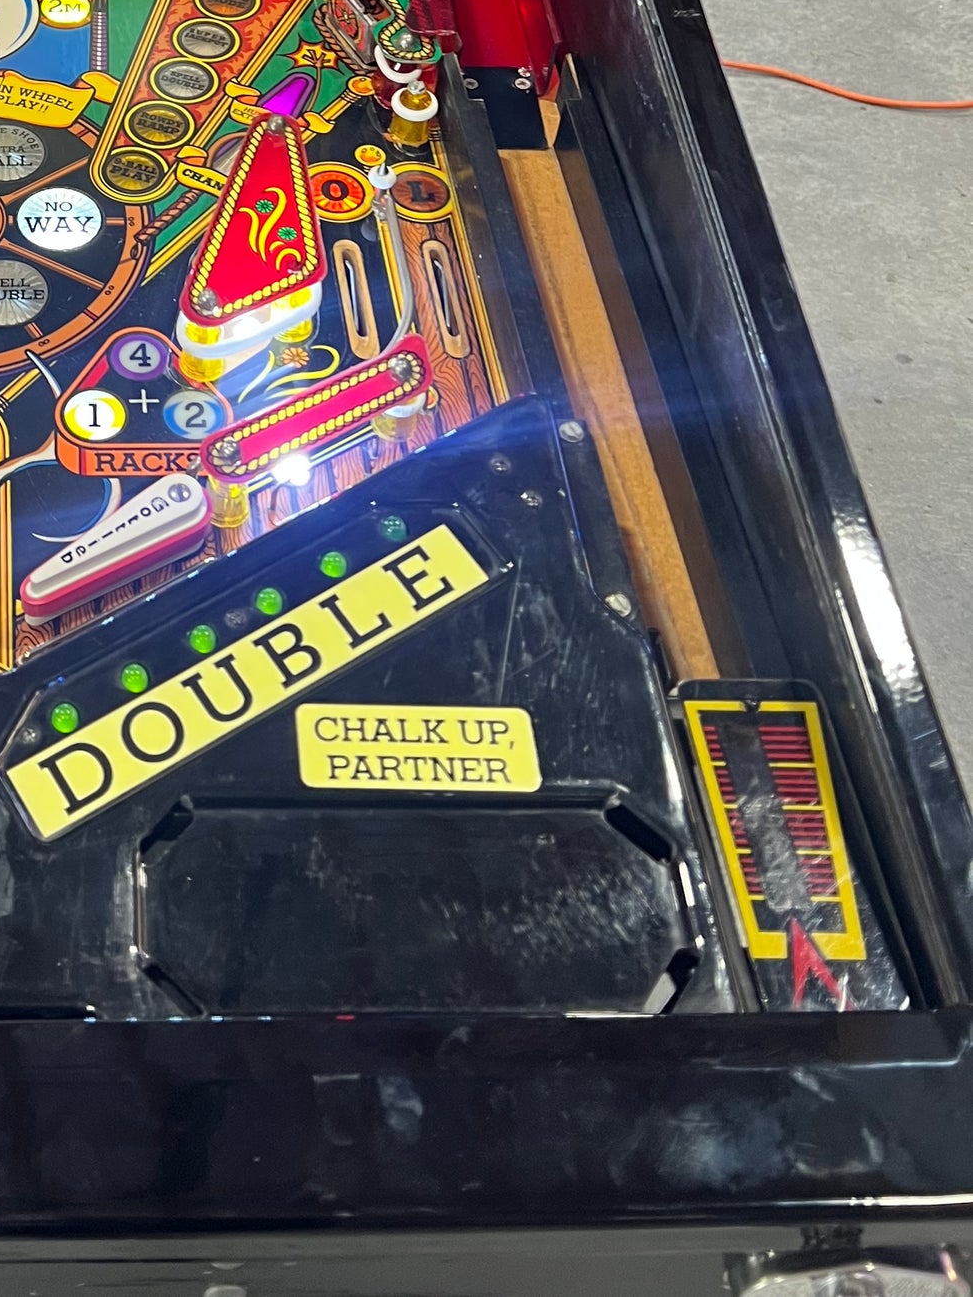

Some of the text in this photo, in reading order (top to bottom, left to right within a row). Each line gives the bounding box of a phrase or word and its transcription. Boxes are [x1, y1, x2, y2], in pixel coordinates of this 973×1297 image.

[48, 0, 81, 14] 2M
[184, 33, 228, 48] JACKPOT
[189, 28, 227, 41] SUPER
[160, 75, 206, 92] DOUBLE
[169, 71, 201, 83] SPELL
[19, 87, 75, 112] WHEEL
[136, 118, 180, 135] RAMP
[140, 111, 184, 129] ROWDY
[10, 127, 40, 151] SHOE
[109, 165, 156, 183] PLAY
[113, 157, 158, 175] 9-BALL
[181, 168, 225, 191] CHAN
[407, 180, 438, 202] L
[44, 201, 73, 212] NO
[24, 216, 95, 234] WAY
[129, 343, 152, 367] 4
[88, 401, 207, 429] 1 2
[39, 544, 455, 817] DOUBLE
[314, 717, 517, 751] CHALK UP,
[328, 755, 512, 784] PARTNER
